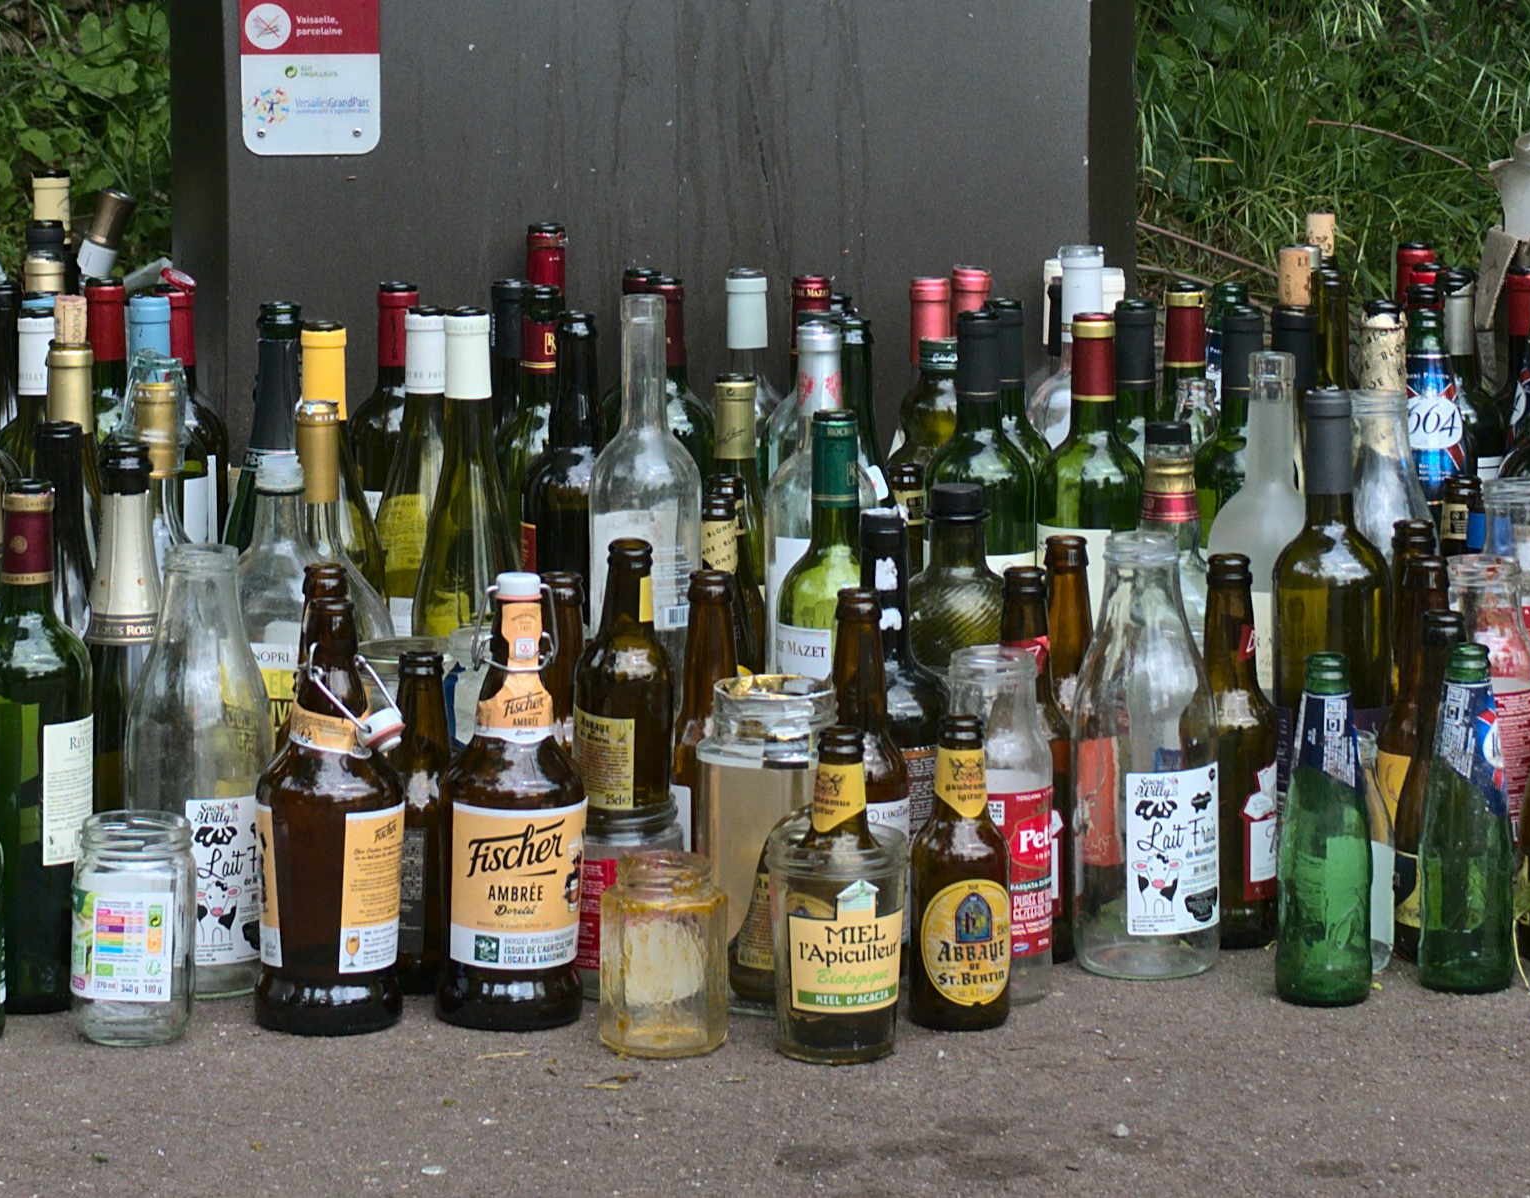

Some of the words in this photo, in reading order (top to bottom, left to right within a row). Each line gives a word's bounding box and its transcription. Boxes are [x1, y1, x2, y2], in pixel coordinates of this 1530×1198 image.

[296, 15, 339, 25] Vaisselle,
[296, 26, 343, 37] porcelaine
[1408, 402, 1459, 438] 664
[126, 624, 155, 636] ROED
[788, 640, 826, 657] MAZET
[503, 691, 544, 718] Fischer
[467, 818, 566, 878] Fischer
[197, 848, 247, 880] Lait
[488, 882, 544, 901] AMBRÉE
[824, 923, 886, 945] MIEL
[799, 936, 899, 968] l'Apiculteur
[937, 939, 1006, 962] ABBAYE
[816, 968, 889, 990] Biologique
[815, 993, 841, 1005] MIEL
[846, 986, 890, 1005] D'ACACIA
